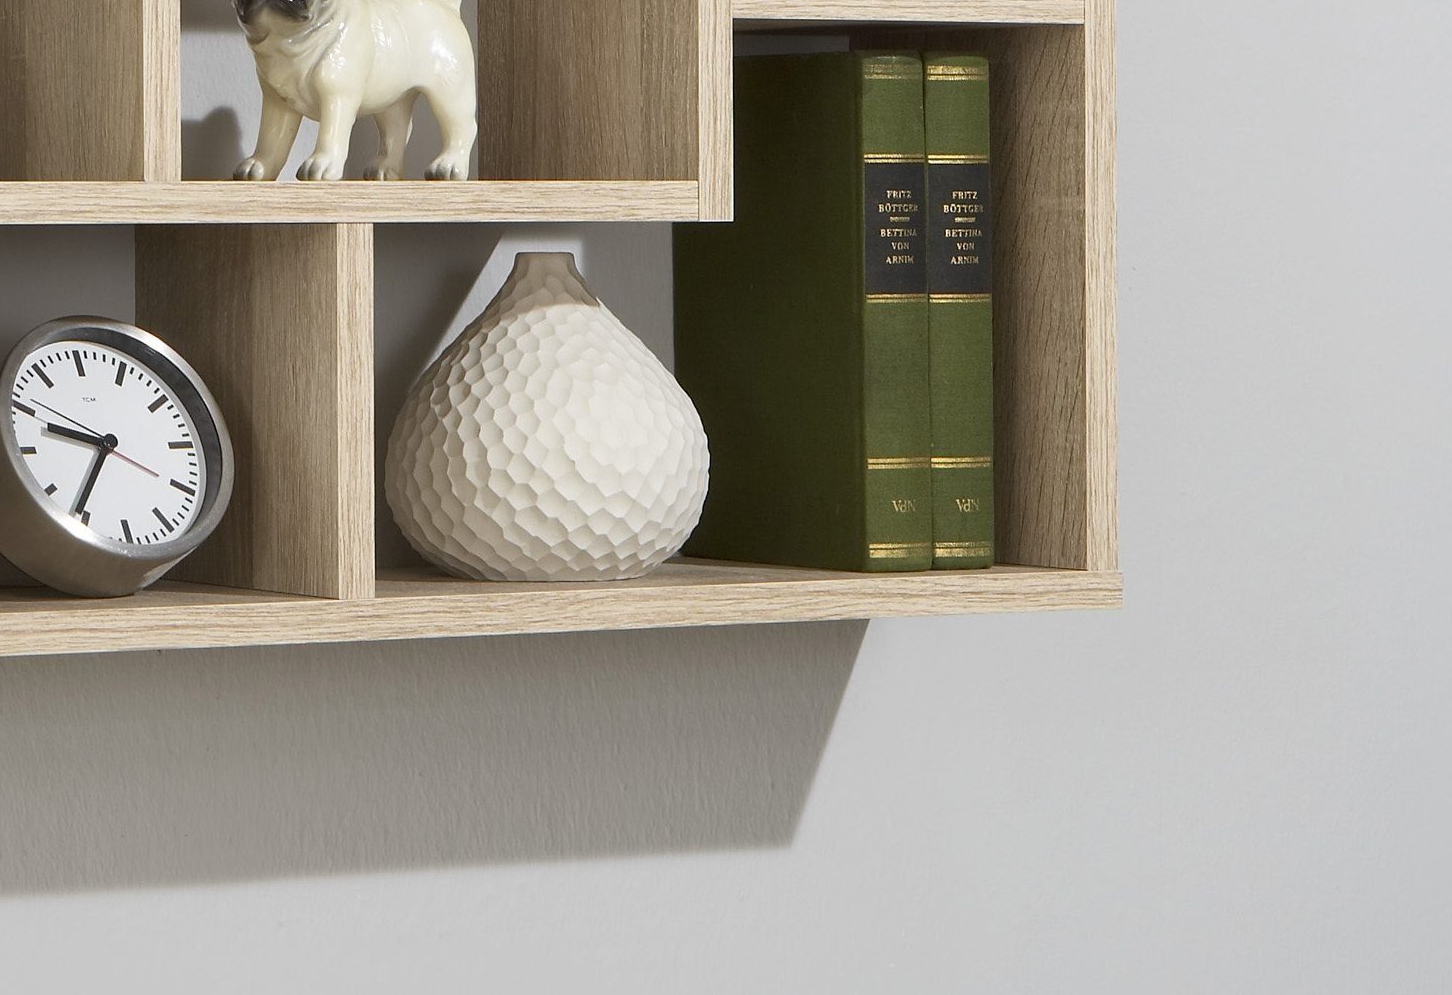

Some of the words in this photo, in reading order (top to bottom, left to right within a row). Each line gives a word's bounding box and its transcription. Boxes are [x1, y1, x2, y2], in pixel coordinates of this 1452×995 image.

[886, 190, 912, 199] FRITZ
[952, 191, 978, 200] FRITZ
[878, 203, 918, 213] BÖTTGER
[943, 203, 984, 213] BÖTTGER
[880, 228, 918, 238] BETTINA
[945, 228, 983, 238] BETTINA
[891, 241, 910, 250] VON
[956, 242, 975, 251] VON
[886, 255, 914, 265] ARNIM
[950, 256, 979, 265] ARNIM
[891, 499, 916, 513] VdN
[955, 498, 980, 513] VdN
